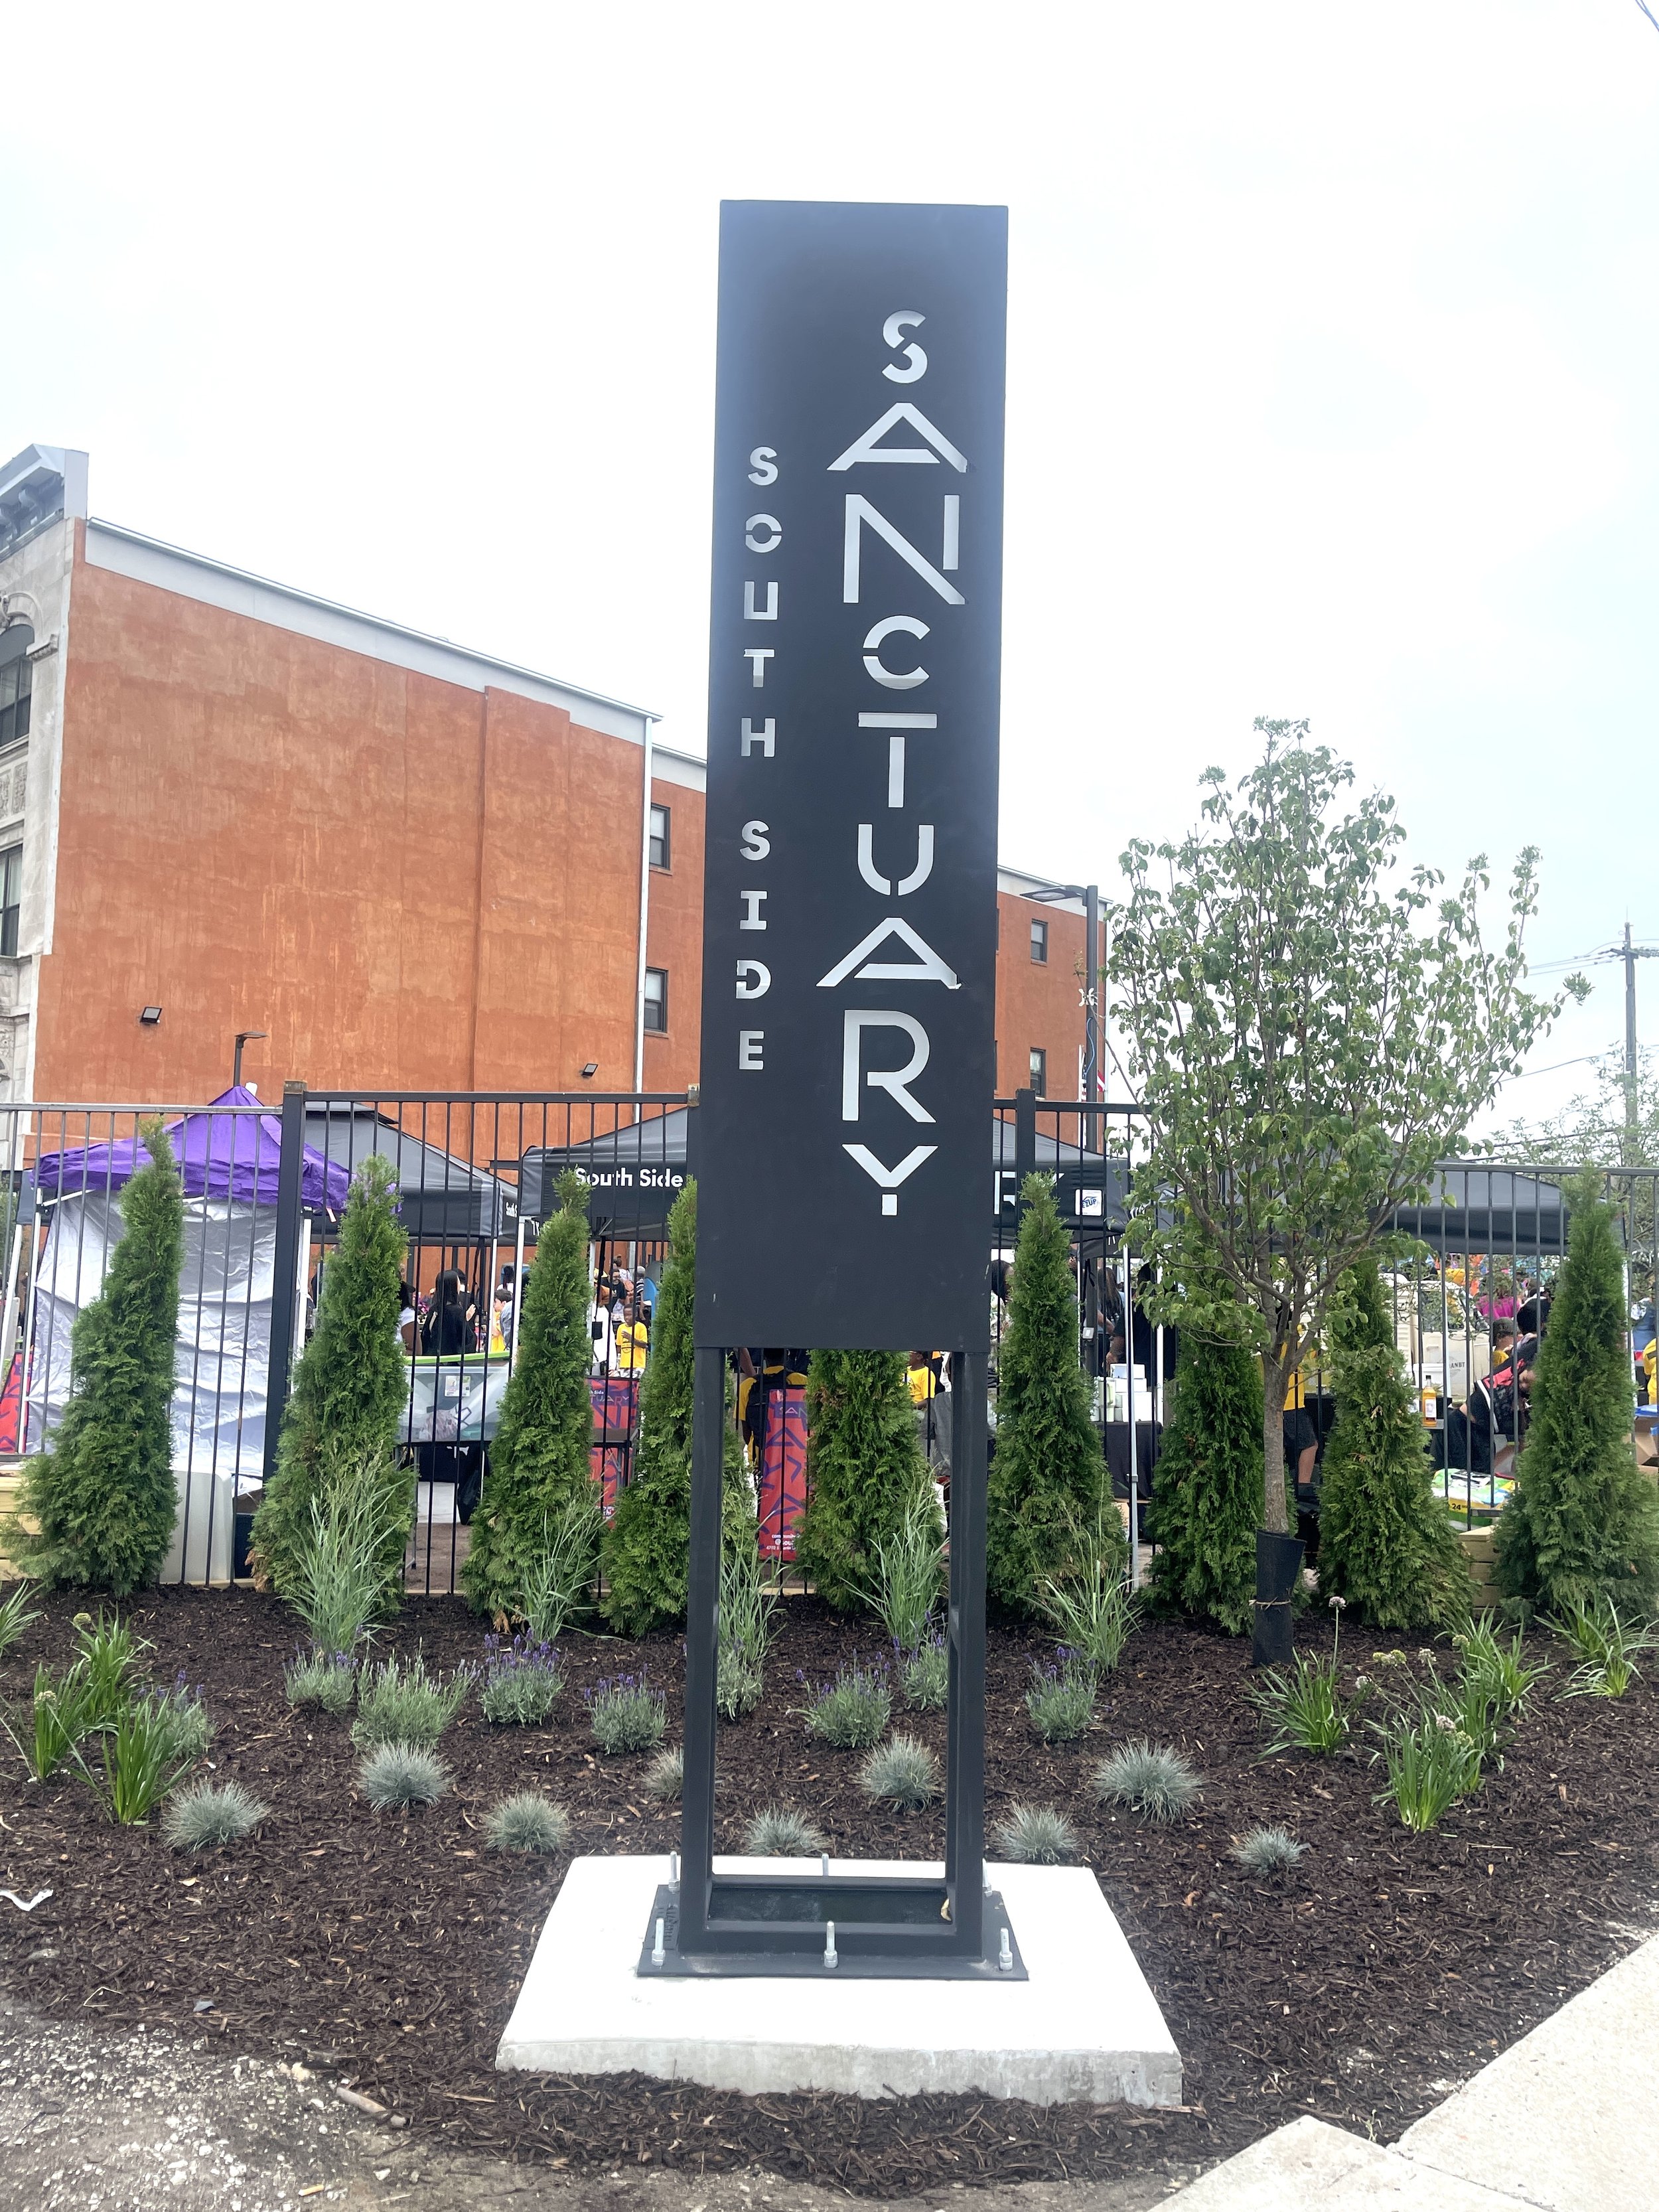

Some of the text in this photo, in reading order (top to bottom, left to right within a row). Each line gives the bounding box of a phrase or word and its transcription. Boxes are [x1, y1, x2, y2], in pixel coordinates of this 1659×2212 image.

[735, 446, 782, 1070] SOUTH SIDE
[816, 310, 968, 1216] SANCTUARY
[575, 1167, 684, 1187] South Side
